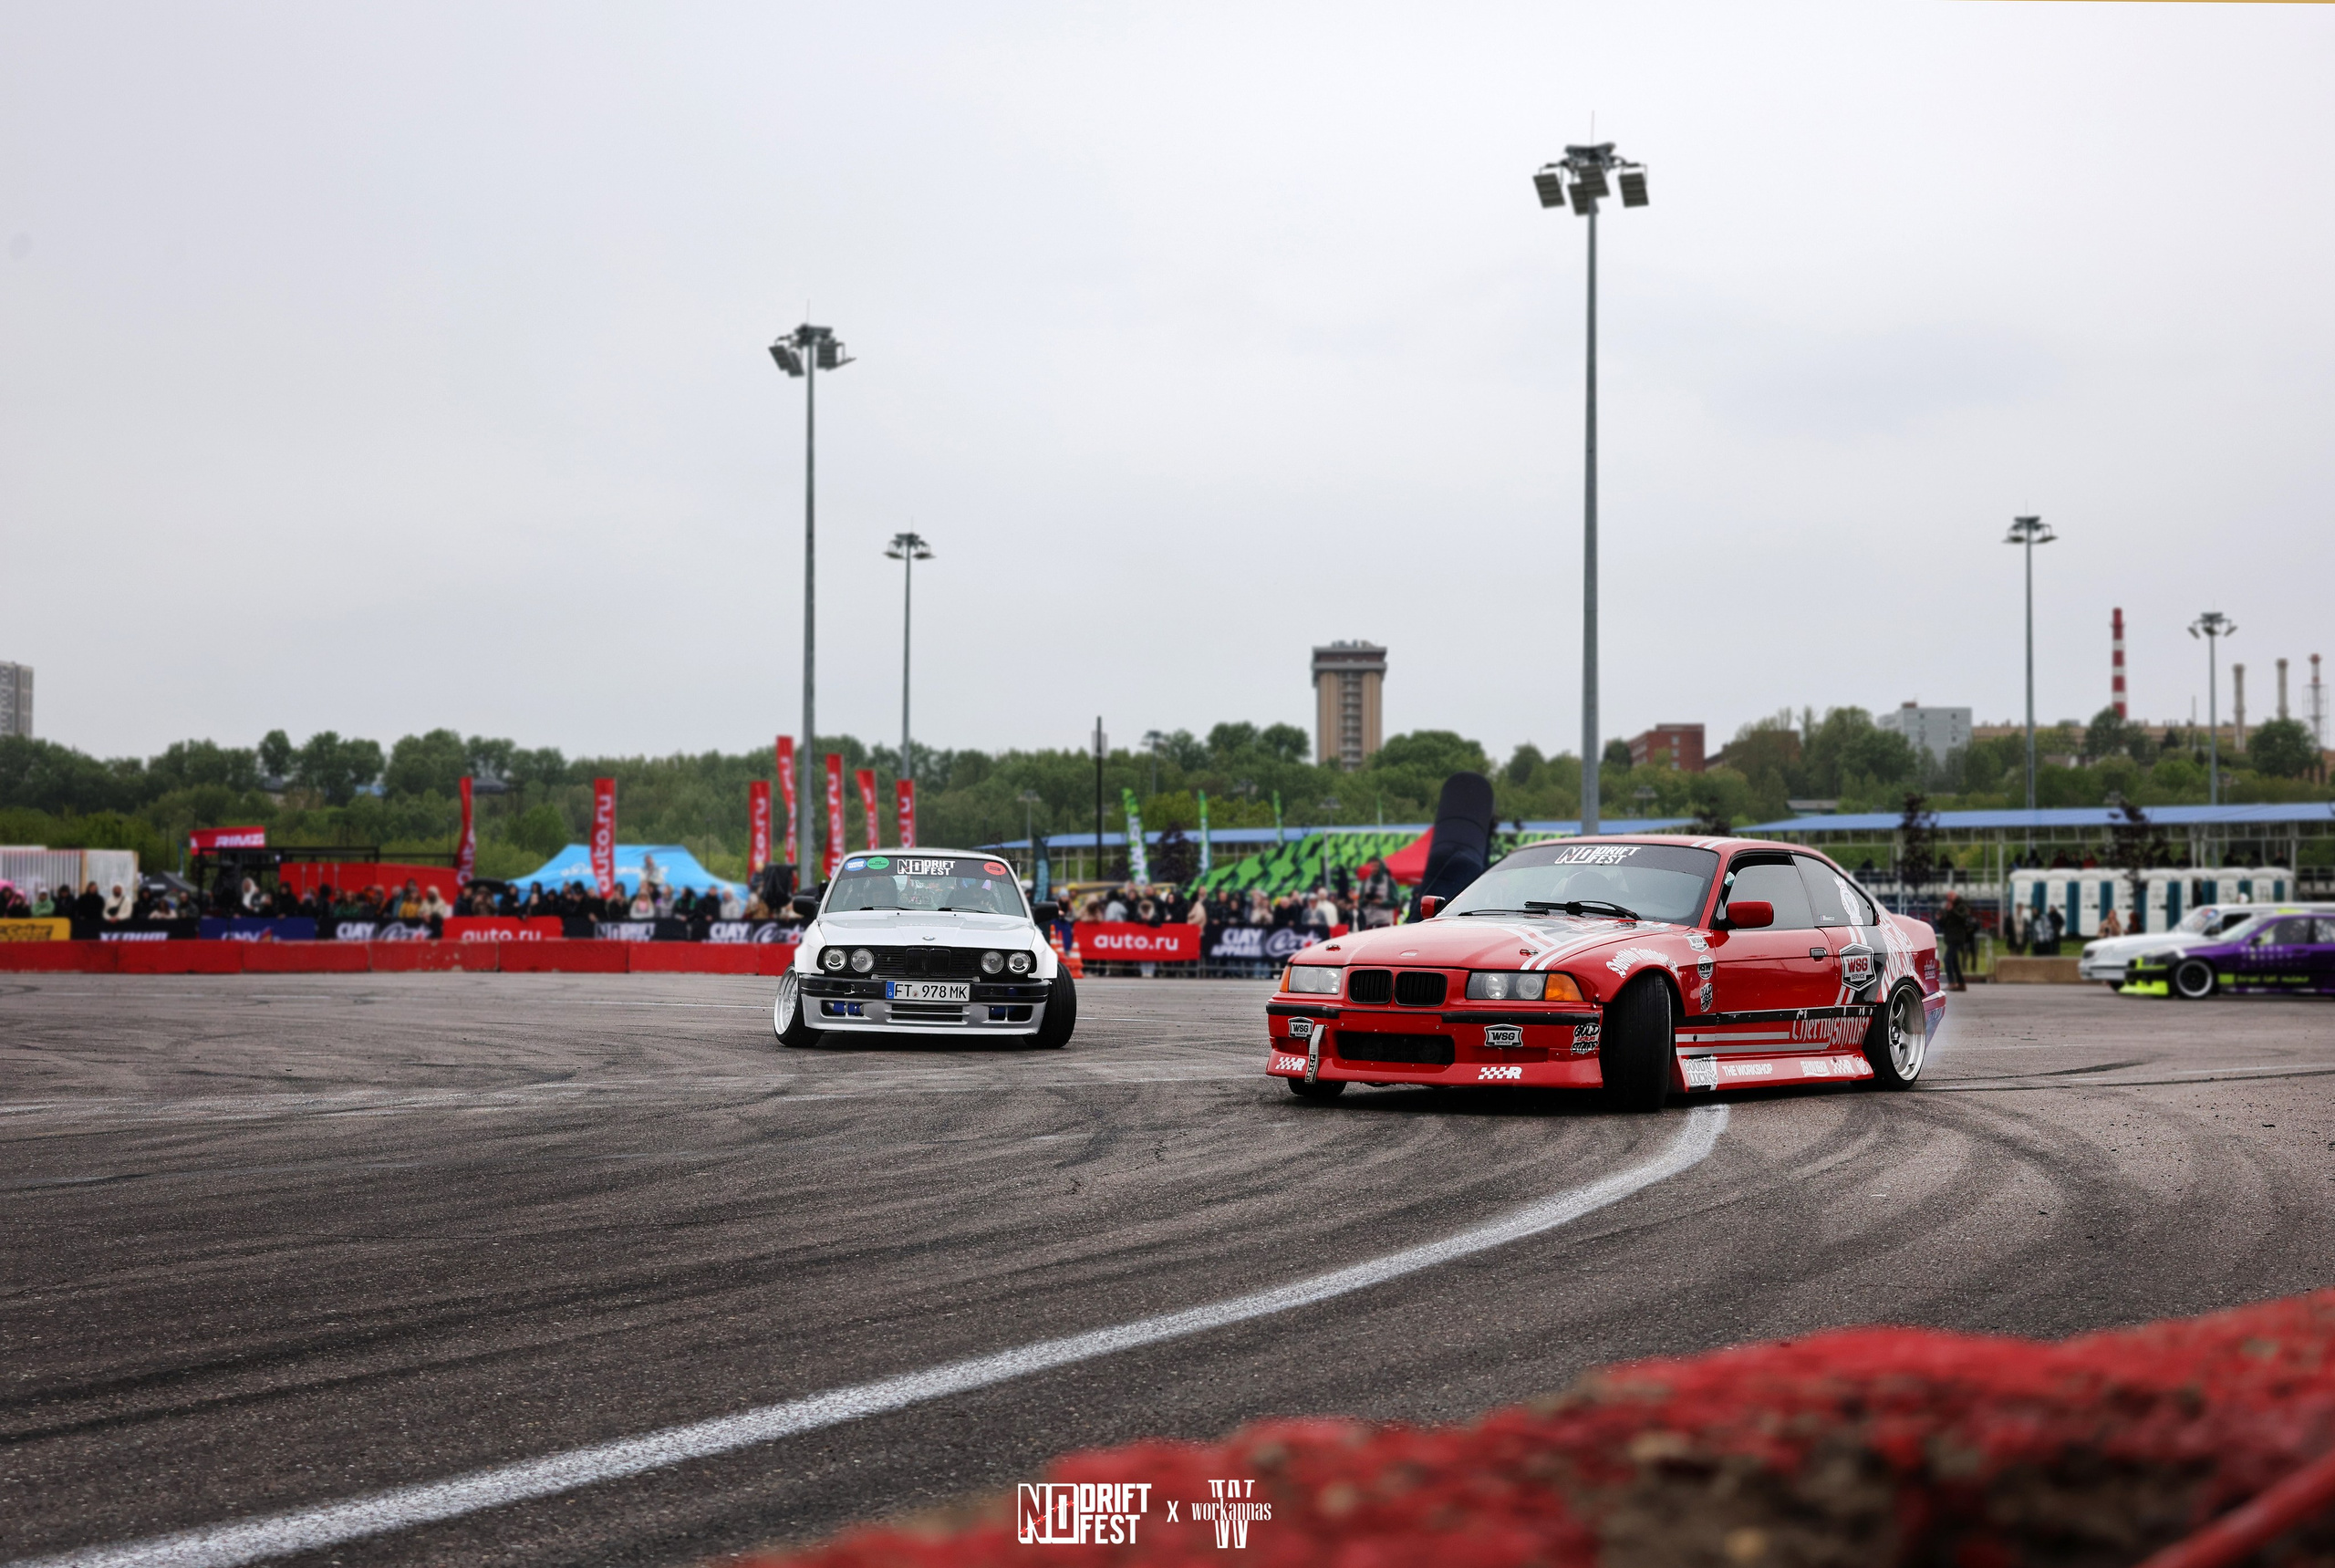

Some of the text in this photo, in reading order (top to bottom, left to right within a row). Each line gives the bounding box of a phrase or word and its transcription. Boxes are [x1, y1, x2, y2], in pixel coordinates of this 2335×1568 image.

[753, 797, 767, 862] to.ru
[596, 794, 611, 892] auto.ru
[1595, 846, 1641, 856] DRIFT
[925, 859, 955, 868] DRIFT
[1587, 855, 1626, 864] FEST
[925, 867, 950, 876] FEST
[462, 929, 542, 941] auto.ru
[1094, 934, 1178, 950] auto.ru
[1846, 958, 1868, 972] WSG
[895, 984, 967, 999] FT 978 MK
[1292, 1024, 1309, 1033] WSG
[1722, 1064, 1772, 1076] THE WORKSHOP
